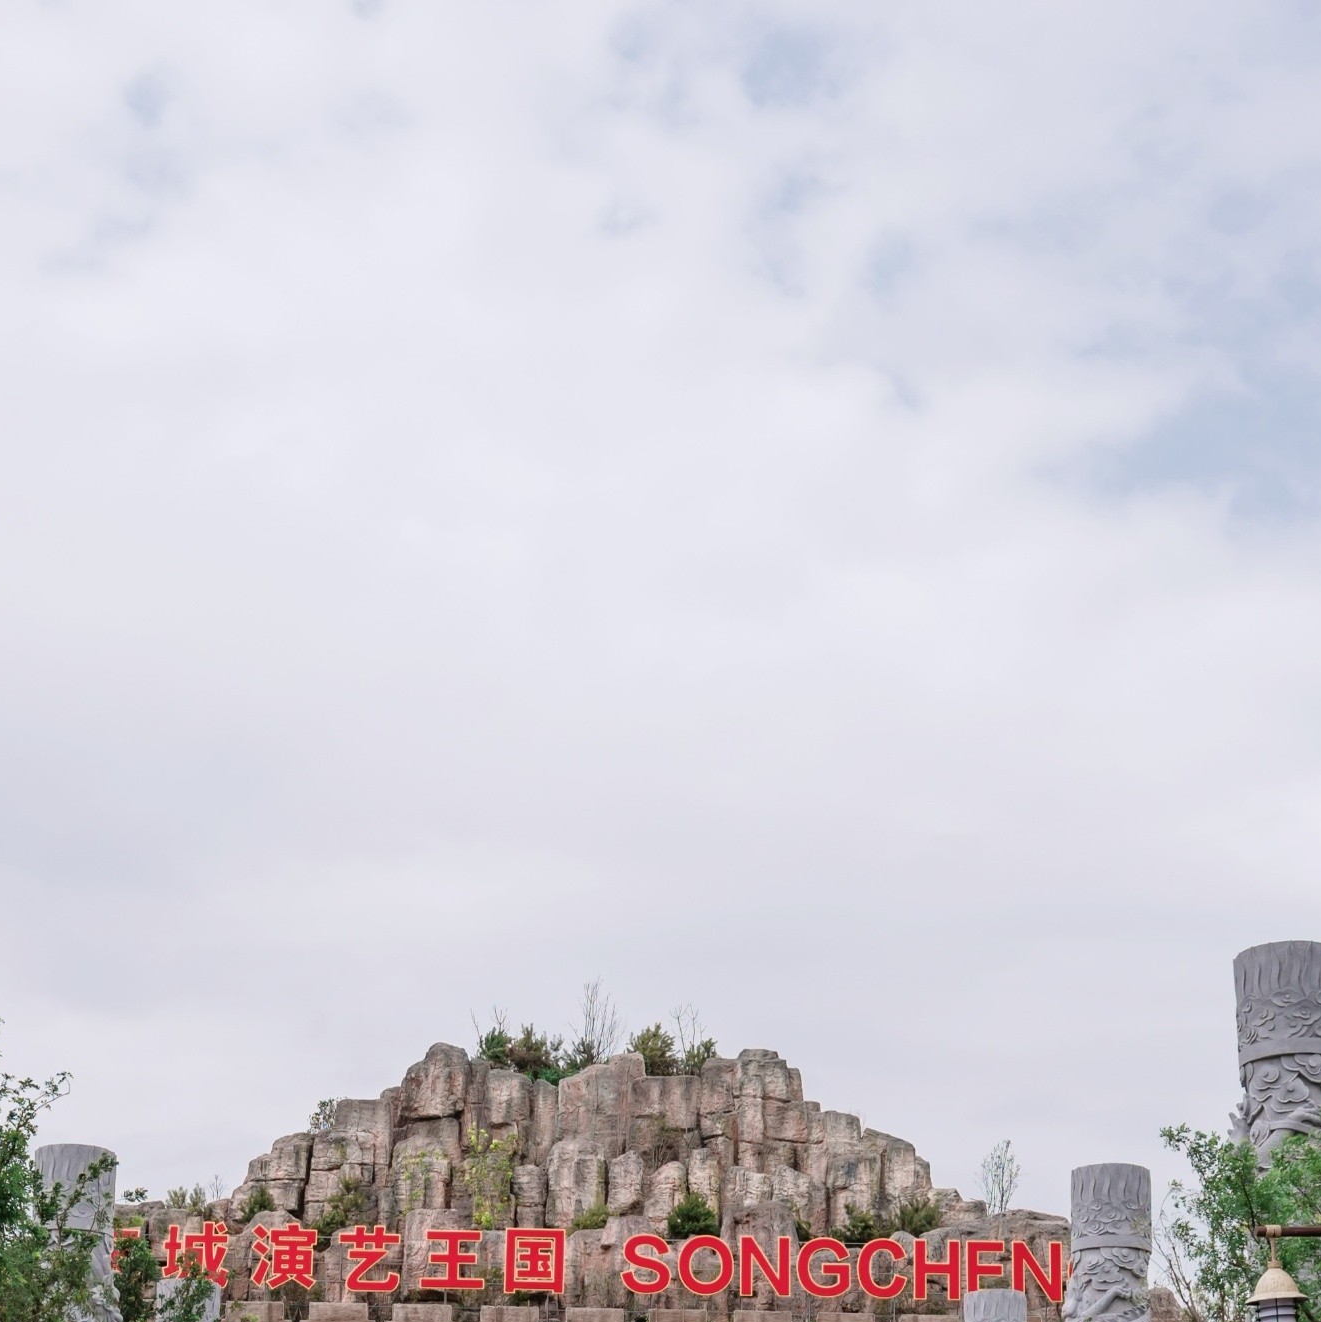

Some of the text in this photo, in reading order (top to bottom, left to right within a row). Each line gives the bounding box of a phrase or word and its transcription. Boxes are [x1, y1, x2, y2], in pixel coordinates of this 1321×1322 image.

[111, 1222, 1073, 1303] 城演艺王国 SONGCHEN
